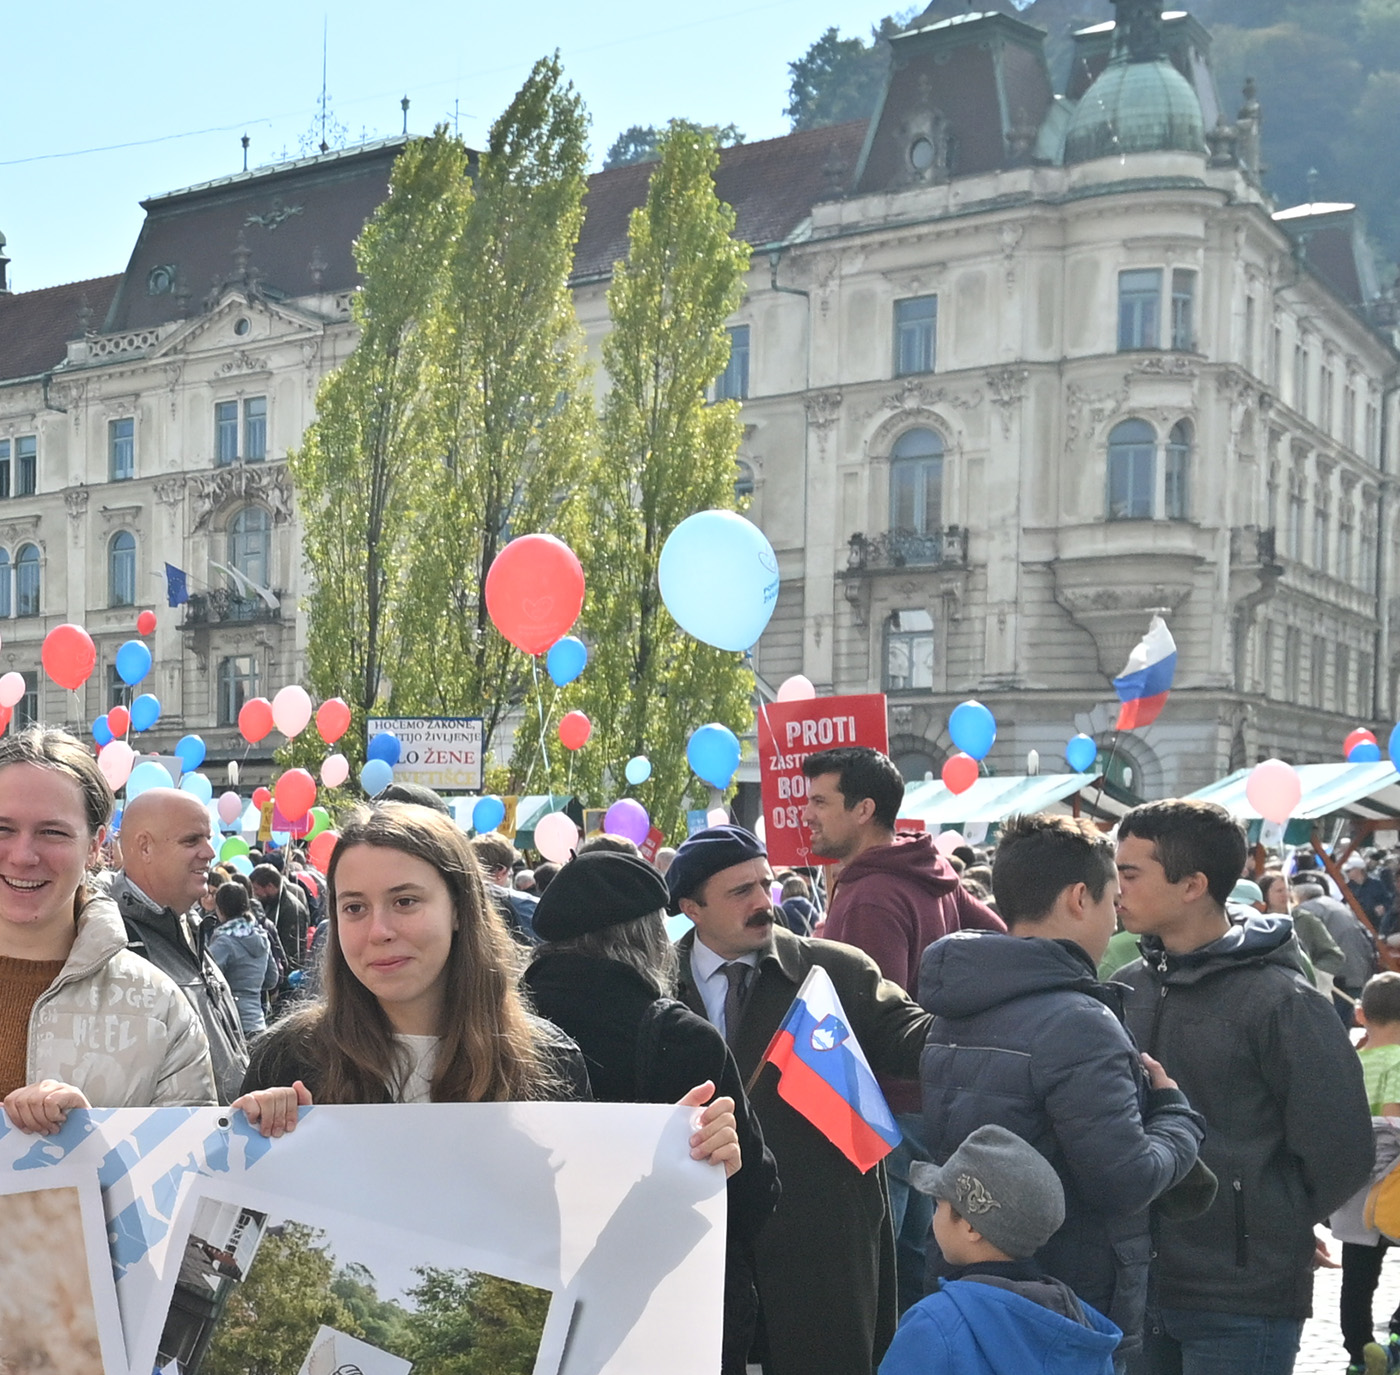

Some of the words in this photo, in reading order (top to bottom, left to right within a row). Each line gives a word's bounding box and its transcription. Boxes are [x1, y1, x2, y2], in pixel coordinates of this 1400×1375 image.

[375, 718, 424, 730] HOČEMO
[427, 718, 476, 731] ZAKONE,
[786, 716, 857, 748] PROTI
[425, 730, 481, 744] ŽIVLJENJE
[424, 747, 476, 765] ŽENE
